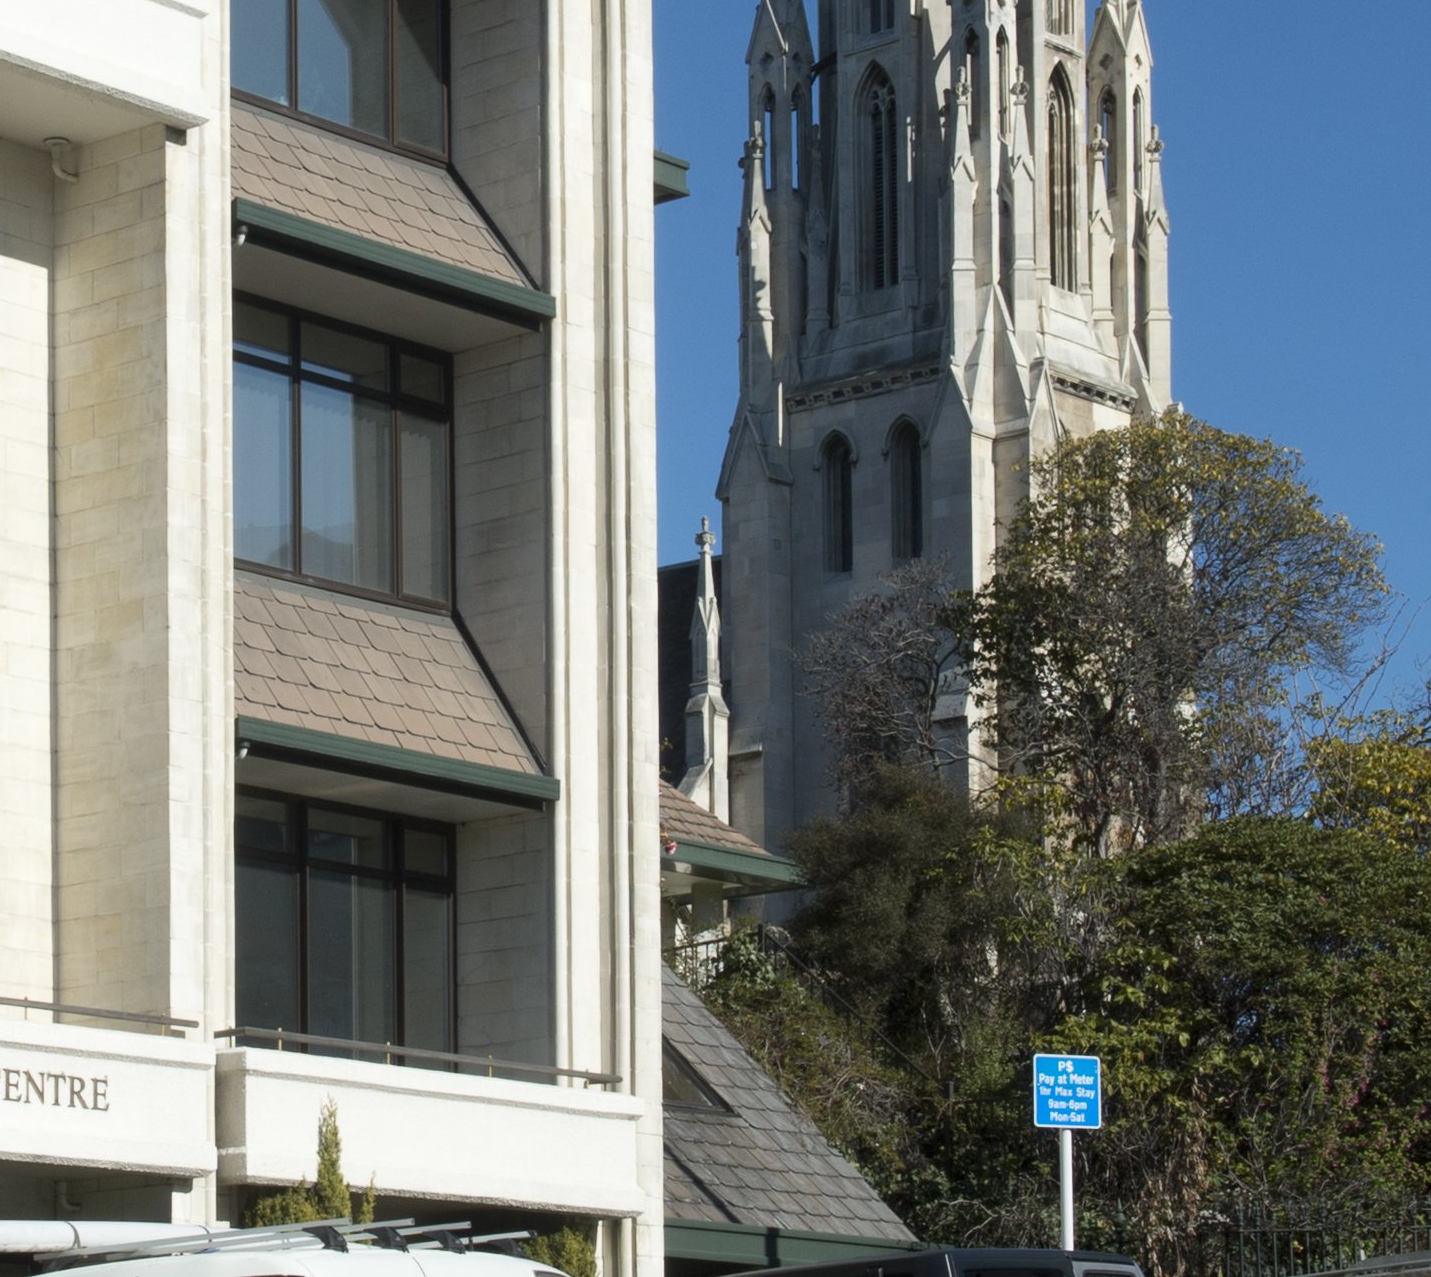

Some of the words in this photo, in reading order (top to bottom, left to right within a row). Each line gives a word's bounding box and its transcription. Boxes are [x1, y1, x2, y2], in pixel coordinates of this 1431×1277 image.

[1058, 1060, 1074, 1073] P$
[1038, 1073, 1055, 1086] Pay
[1057, 1074, 1068, 1085] at
[1069, 1073, 1095, 1085] Meter
[1055, 1086, 1073, 1097] Max
[1076, 1087, 1096, 1100] Stay
[1050, 1111, 1086, 1123] Mon-Sat
